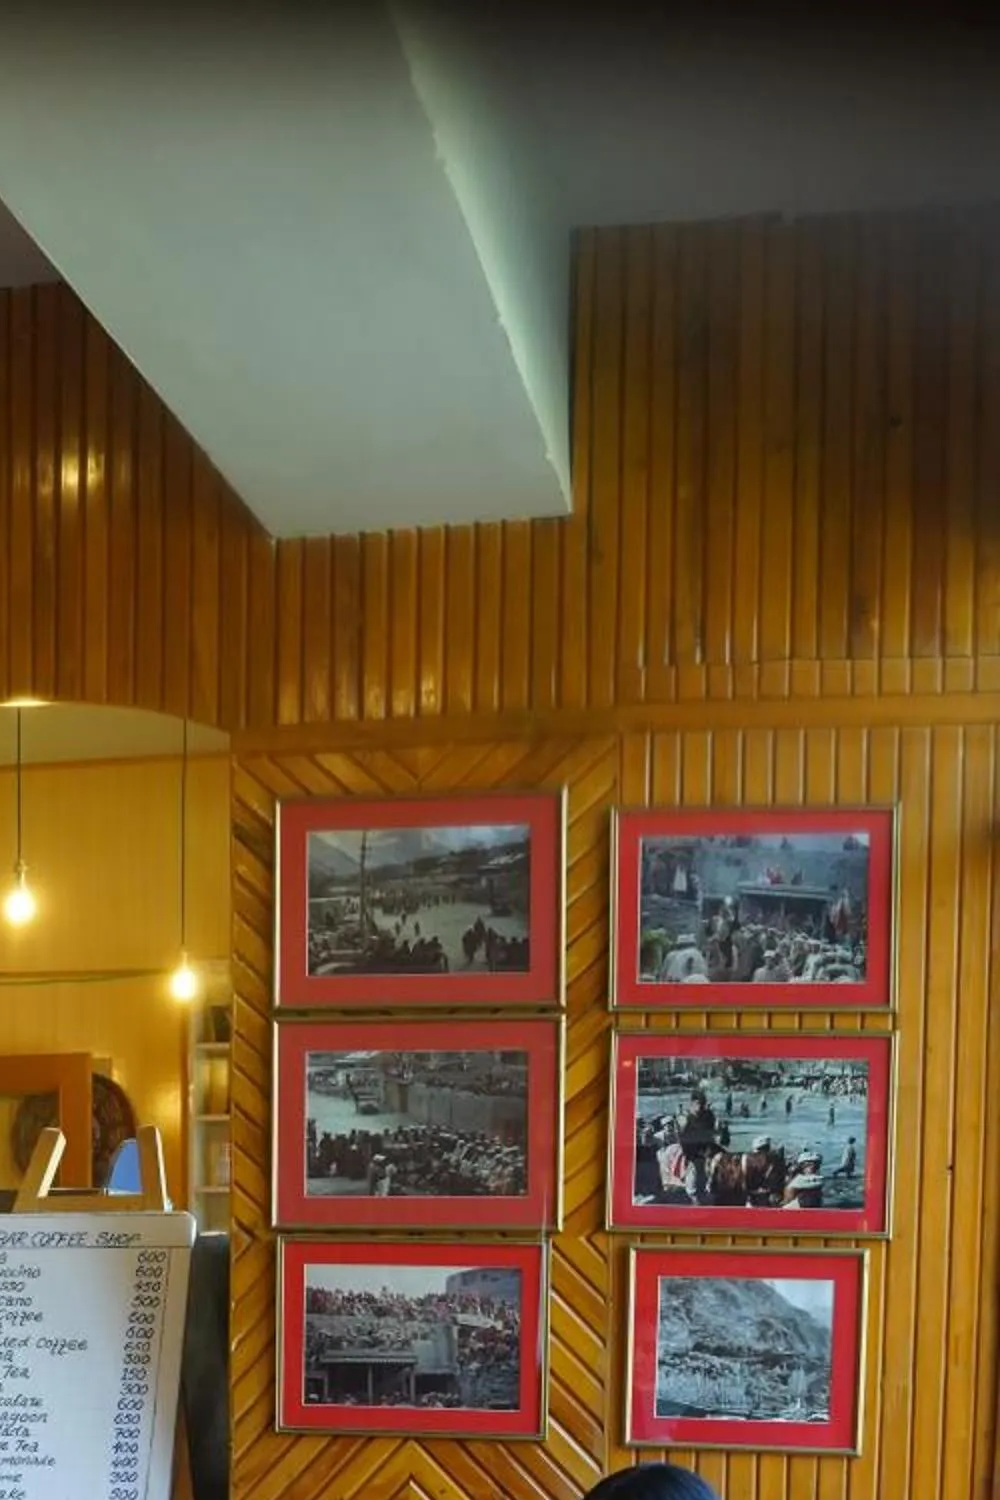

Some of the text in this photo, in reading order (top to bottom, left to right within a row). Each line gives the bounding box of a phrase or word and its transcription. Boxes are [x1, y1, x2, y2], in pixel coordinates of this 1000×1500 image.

[31, 1231, 89, 1248] COFFEE
[96, 1231, 142, 1248] SHOP
[137, 1250, 167, 1263] 600
[126, 1326, 155, 1339] 600
[1, 1364, 30, 1379] Tea
[120, 1382, 149, 1396] 300
[117, 1398, 144, 1411] 600
[113, 1412, 141, 1424] 650
[114, 1427, 141, 1440] 700
[15, 1439, 39, 1453] Tea
[112, 1441, 139, 1454] 400
[112, 1456, 138, 1468] 400
[109, 1471, 139, 1484] 300
[109, 1487, 139, 1500] 500
